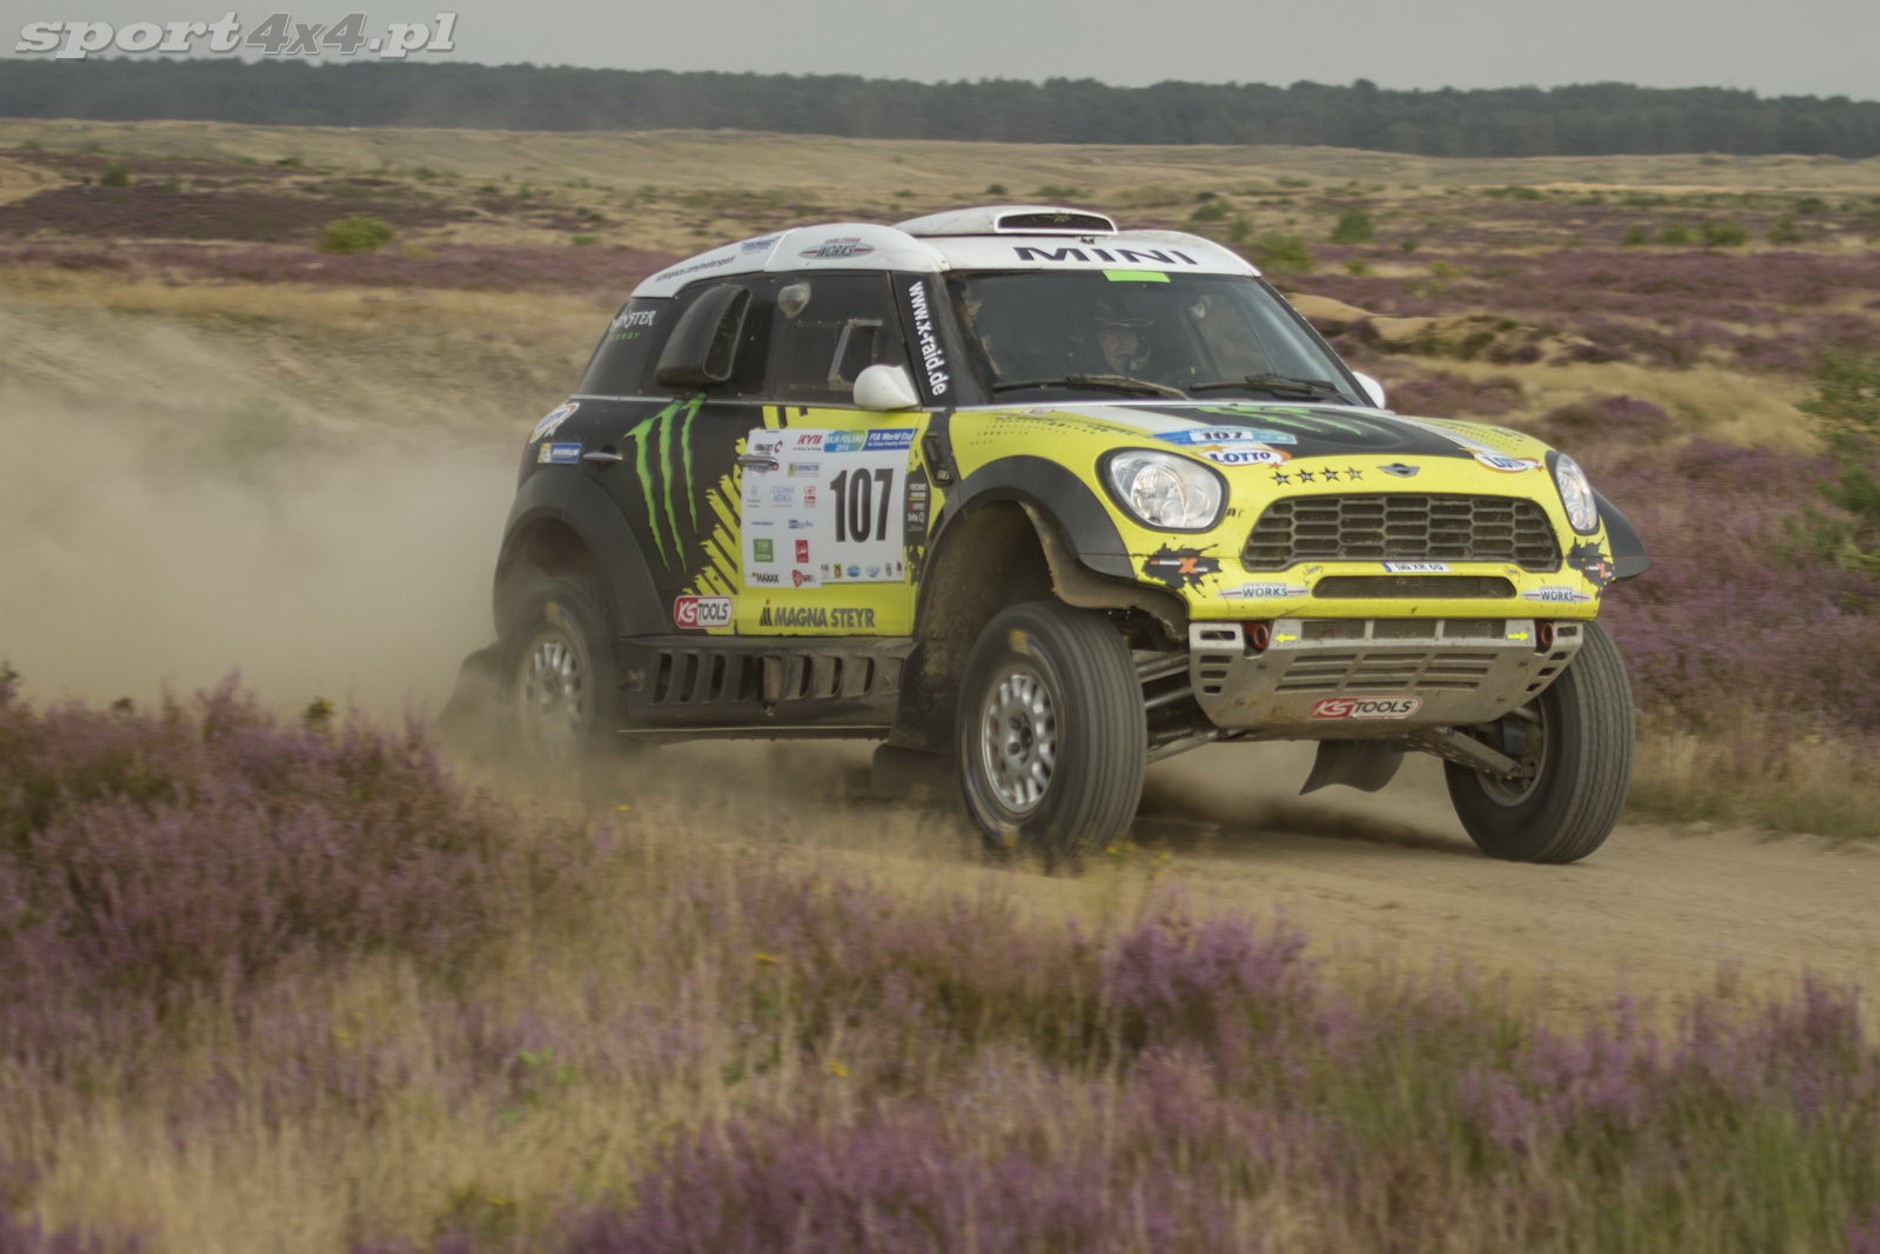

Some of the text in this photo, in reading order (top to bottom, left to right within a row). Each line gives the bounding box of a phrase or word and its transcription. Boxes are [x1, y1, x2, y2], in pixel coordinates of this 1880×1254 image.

[816, 245, 855, 258] WORKS
[1013, 246, 1198, 266] MINI
[908, 280, 950, 397] www.x-raid.de
[869, 432, 881, 441] FIA
[882, 431, 901, 441] World
[1204, 431, 1244, 441] 107
[1208, 450, 1272, 464] LOTTO
[829, 467, 894, 543] 107
[1242, 588, 1288, 598] WORKS
[1540, 590, 1575, 601] WORKS
[698, 602, 730, 621] TOOLS
[774, 606, 876, 628] MAGNA STEYR
[1353, 701, 1412, 714] TOOLS
